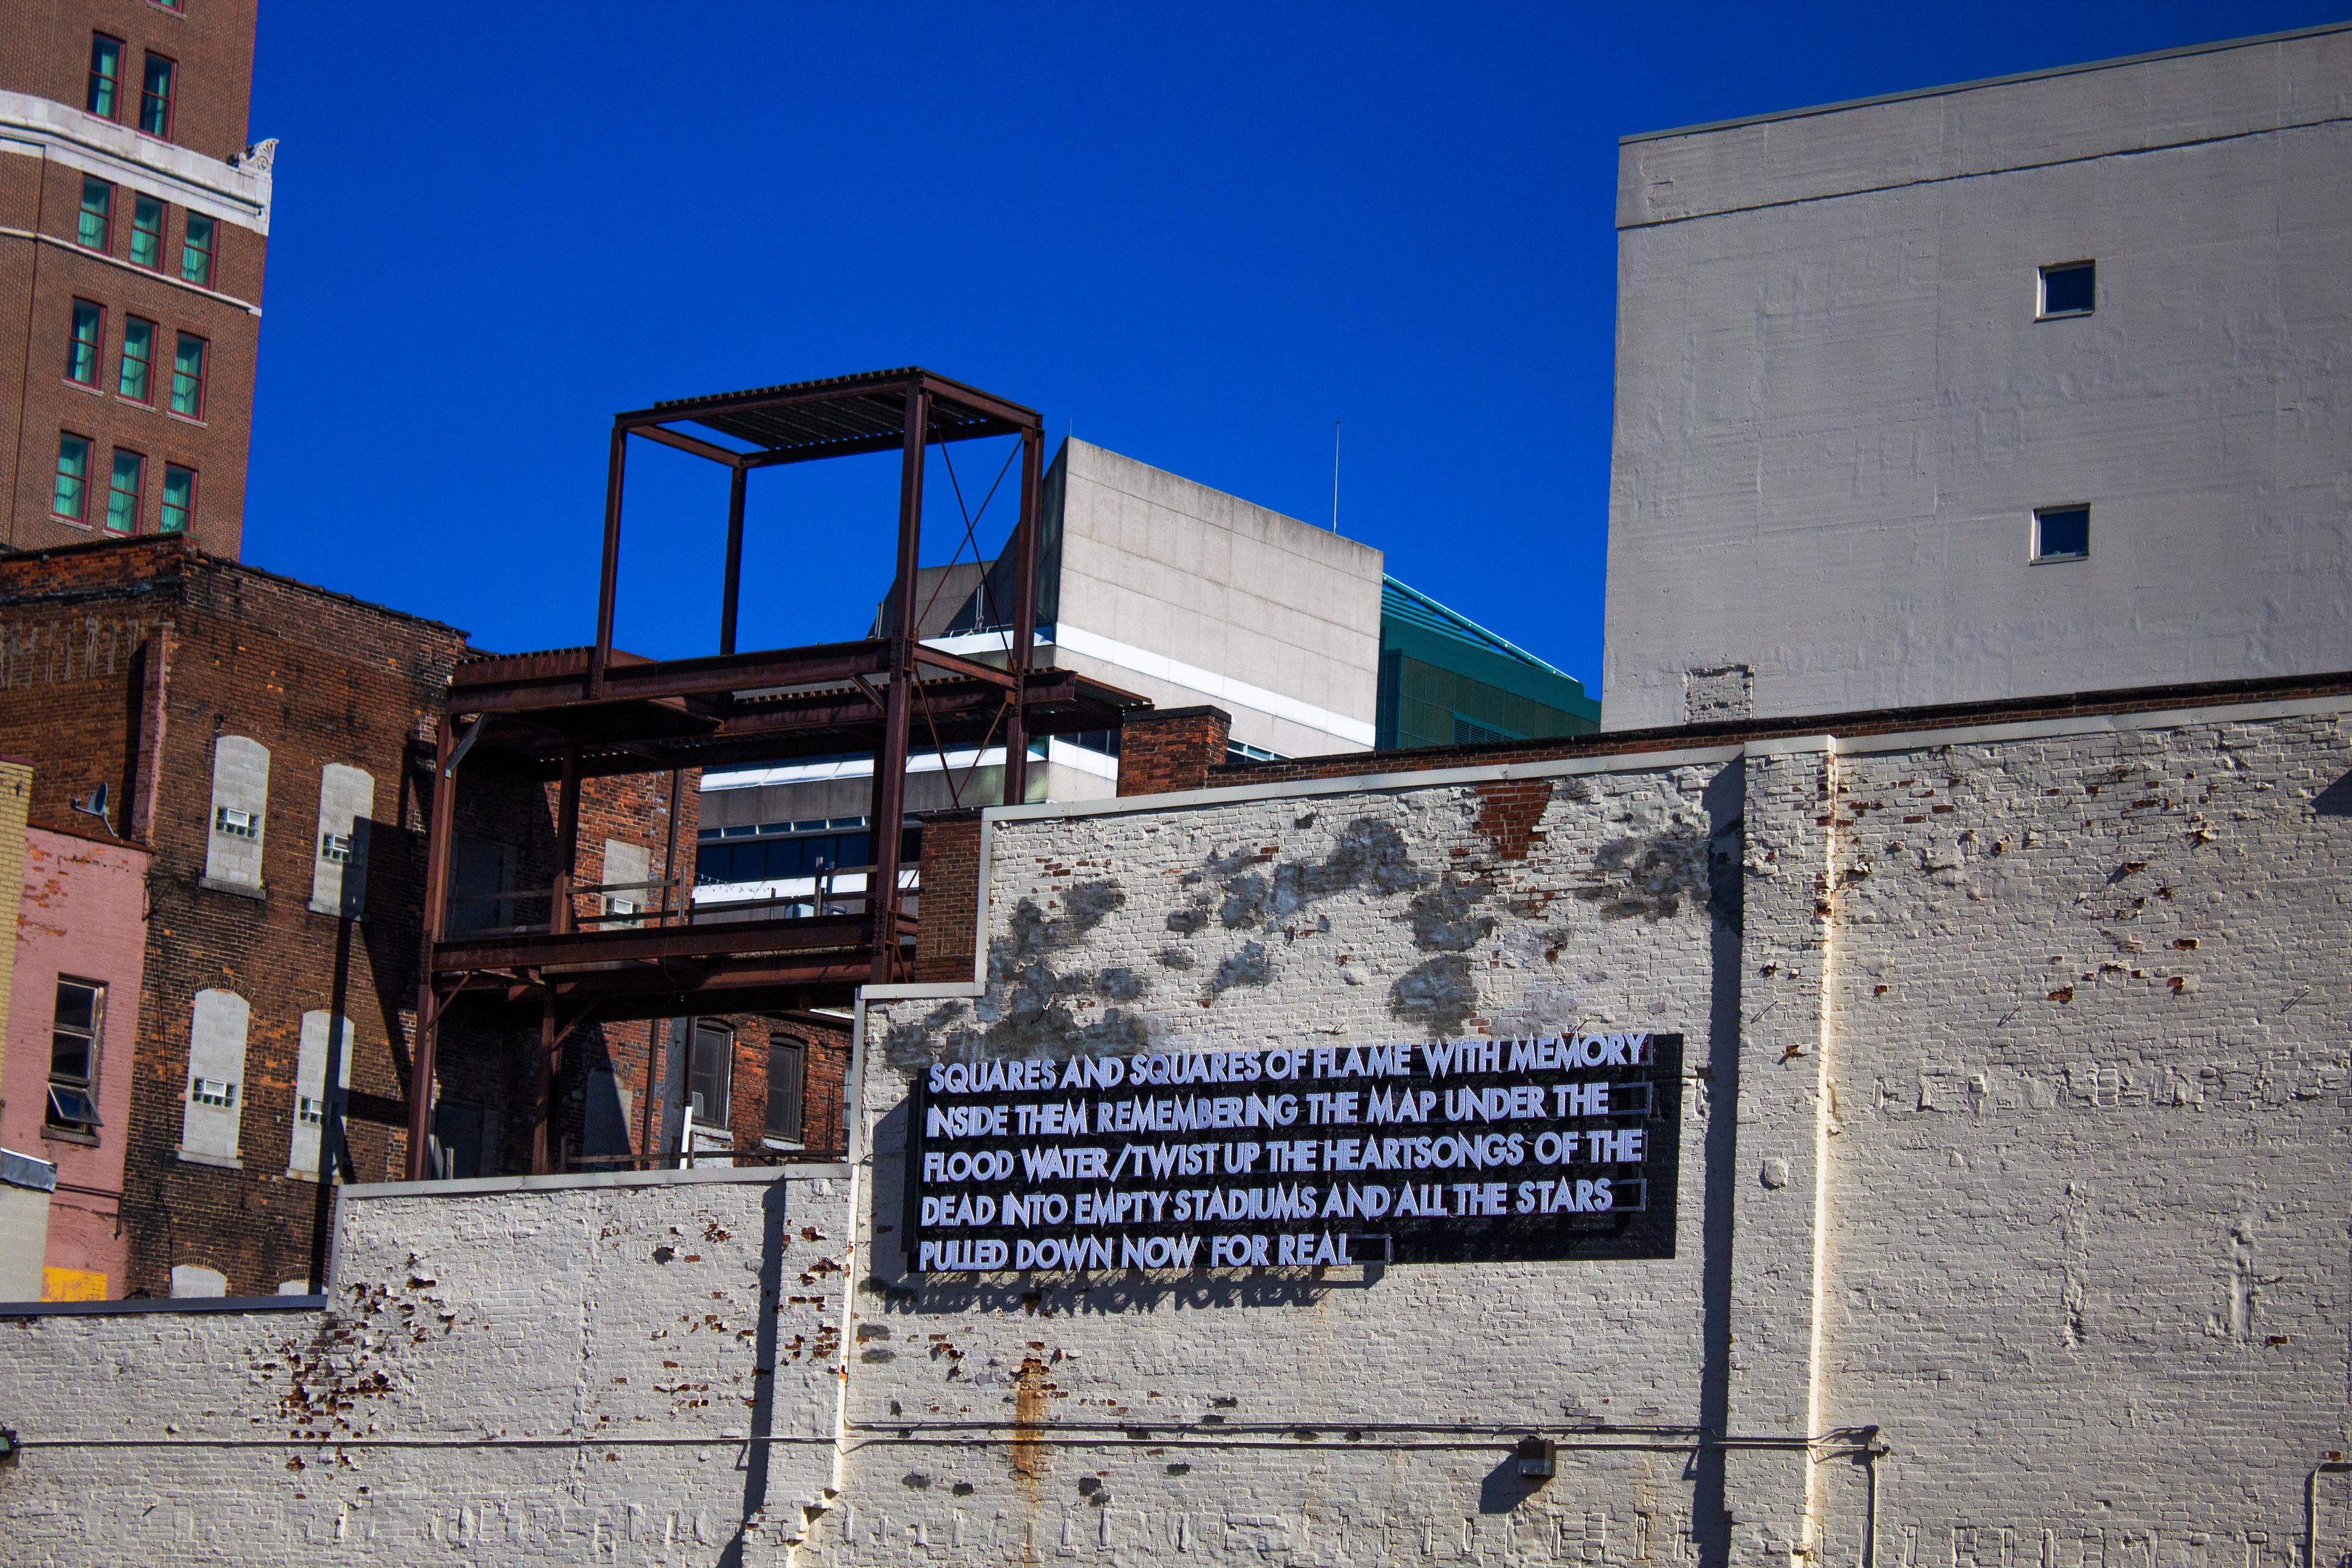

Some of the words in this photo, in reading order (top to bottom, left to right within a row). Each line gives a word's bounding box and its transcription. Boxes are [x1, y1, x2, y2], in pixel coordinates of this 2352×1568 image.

[929, 1058, 1056, 1093] SQUARES
[1060, 1054, 1125, 1091] AND
[1130, 1050, 1261, 1085] SQUARES
[1265, 1048, 1307, 1080] OF
[1314, 1039, 1411, 1079] FLAME
[1421, 1038, 1501, 1079] WITH
[1508, 1030, 1647, 1073] MEMORY
[926, 1104, 1008, 1140] INSIDE
[1015, 1098, 1088, 1137] THEM
[1097, 1093, 1298, 1134] REMEMBERING
[1307, 1091, 1359, 1125] THE
[1366, 1085, 1436, 1126] MAP
[1446, 1085, 1547, 1123] UNDER
[1553, 1082, 1608, 1115] THE
[923, 1150, 1014, 1182] FLOOD
[1224, 1142, 1260, 1174] UP
[1266, 1140, 1317, 1173] THE
[1324, 1132, 1524, 1171] HEARTSONGS
[1534, 1132, 1578, 1164] OF
[1587, 1129, 1642, 1162] THE
[921, 1192, 995, 1226] DEAD
[1002, 1191, 1068, 1229] INTO
[1074, 1187, 1169, 1227] EMPTY
[1173, 1182, 1317, 1223] STADIUMS
[1321, 1182, 1390, 1221] AND
[1394, 1180, 1447, 1216] ALL
[1453, 1183, 1507, 1215] THE
[1517, 1176, 1613, 1213] STARS
[919, 1238, 1008, 1271] PULLED
[1016, 1234, 1112, 1273] DOWN
[1121, 1232, 1200, 1272] NOW
[1211, 1234, 1270, 1267] FOR
[1278, 1229, 1352, 1265] REAL
